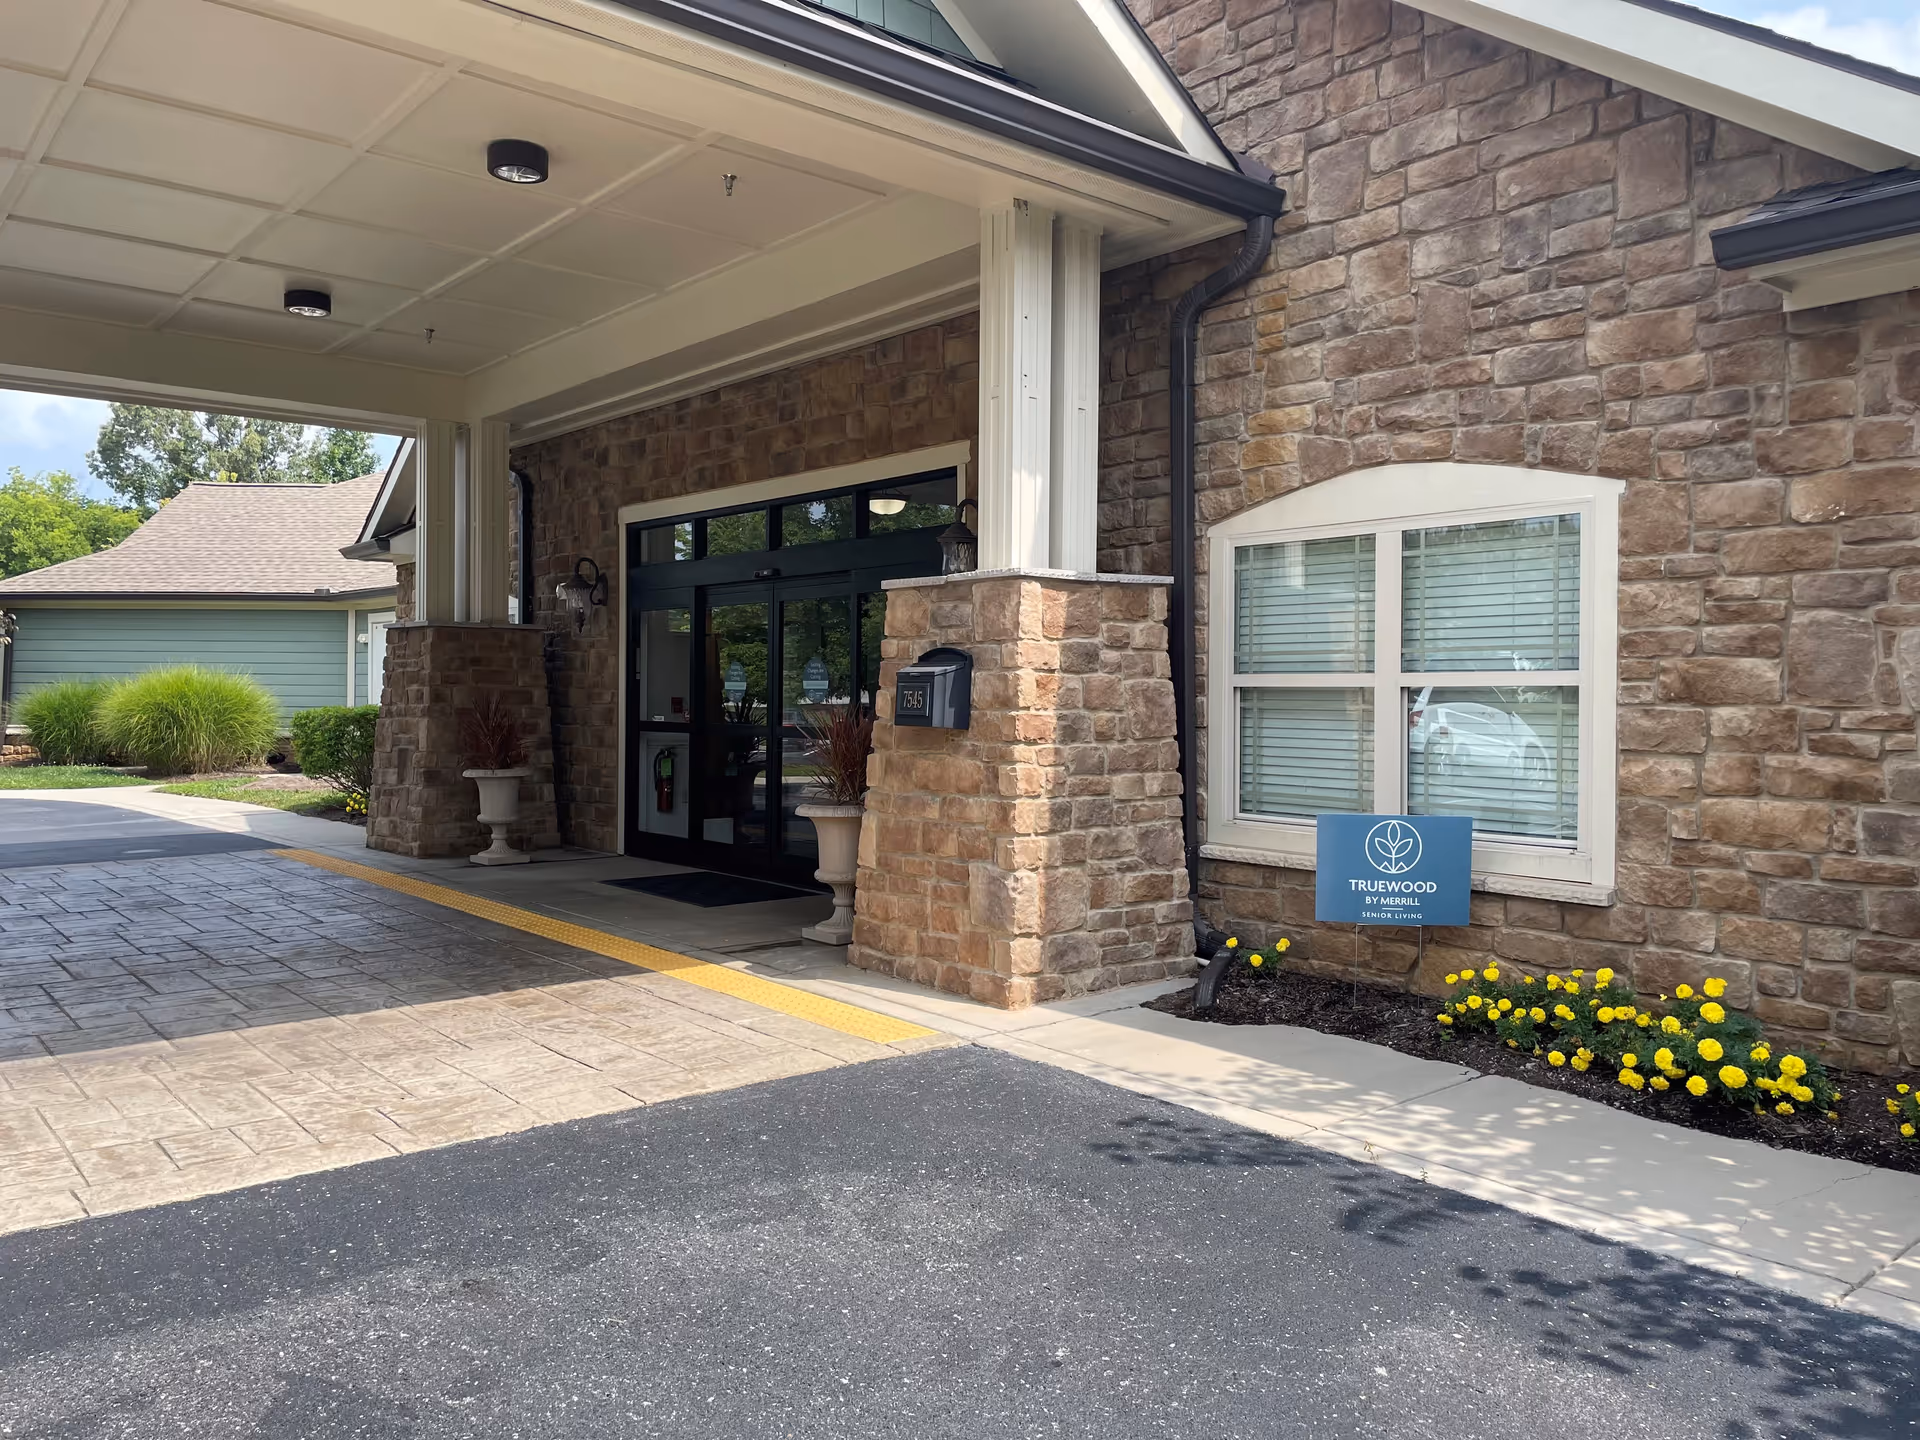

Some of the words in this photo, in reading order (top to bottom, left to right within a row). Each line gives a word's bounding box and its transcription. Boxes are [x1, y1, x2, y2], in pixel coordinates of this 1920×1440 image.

[903, 690, 923, 708] 7545
[1348, 879, 1437, 893] TRUEWOOD
[1365, 896, 1378, 905] BY
[1380, 897, 1420, 906] MERRILL
[1361, 911, 1392, 919] SENIOR
[1395, 912, 1423, 920] LIVING
